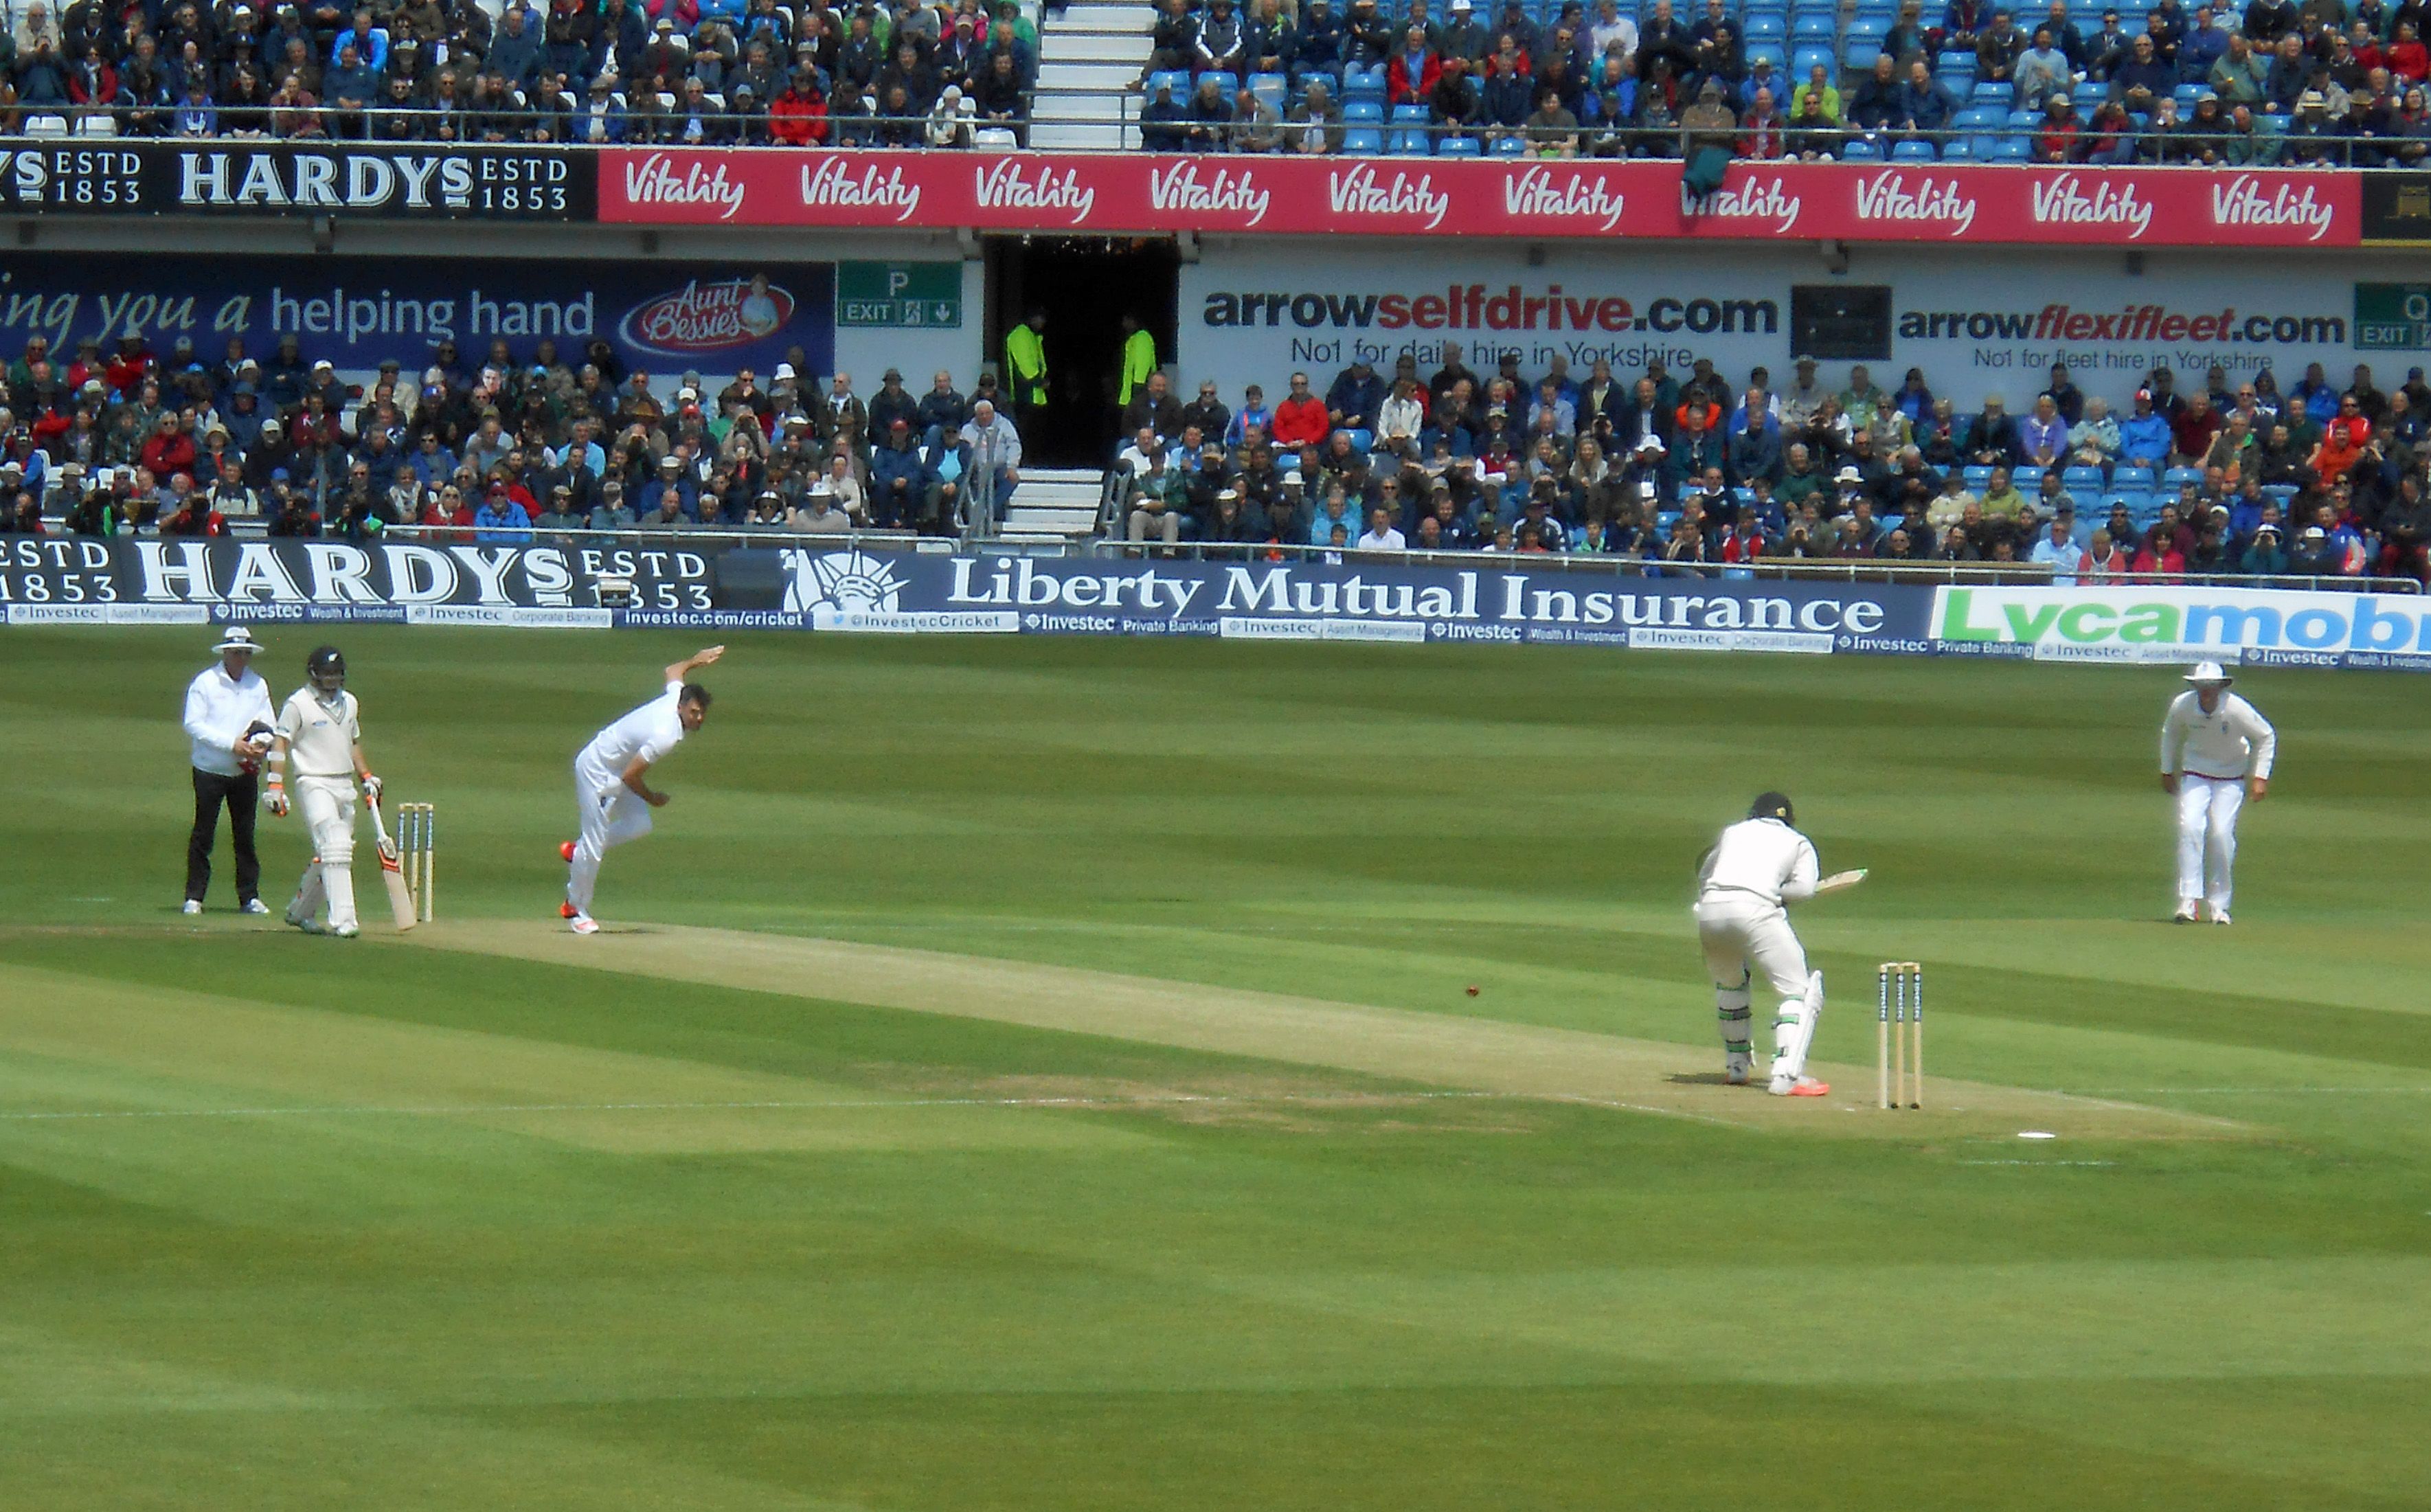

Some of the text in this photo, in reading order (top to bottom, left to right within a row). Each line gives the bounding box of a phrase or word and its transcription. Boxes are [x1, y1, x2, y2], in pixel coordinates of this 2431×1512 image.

[56, 151, 142, 174] ESTD
[483, 159, 567, 181] ESTD
[56, 180, 141, 203] 1853
[179, 153, 474, 208] HARDYS
[626, 153, 745, 218] Vitality
[801, 155, 920, 221] Vitality
[976, 157, 1094, 223] Vitality
[484, 188, 567, 210] 1853
[1151, 159, 1270, 226] Vitality
[1331, 162, 1449, 229] Vitality
[1505, 165, 1624, 231] Vitality
[1857, 169, 1976, 236] Vitality
[2033, 172, 2153, 238] Vitality
[2213, 174, 2333, 240] Vitality
[890, 271, 909, 296] P
[675, 278, 742, 316] Aunt
[95, 292, 196, 343] you
[214, 295, 251, 332] a
[272, 286, 455, 347] helping
[471, 291, 593, 336] hand
[847, 304, 891, 321] EXIT
[1203, 285, 1779, 334] arrowselfdrive.com
[1899, 305, 2345, 344] arrowflexifleet.com
[2364, 327, 2406, 342] EXIT
[1292, 337, 1341, 363] No1
[1353, 339, 1390, 363] for
[1533, 341, 1556, 365] in
[1564, 341, 1693, 368] Yorkshire
[1974, 349, 2274, 371] No1 for fleet hire in Yorkshire
[135, 542, 574, 608] HARDYS
[580, 550, 707, 578] ESTD
[948, 558, 1885, 633] Liberty Mutual Insurance
[30, 605, 98, 618] Investec
[231, 604, 303, 620] Investec
[430, 607, 504, 620] Investec
[626, 609, 803, 627] Investec.com/cricket
[851, 616, 999, 628] @InvestecCricket
[1042, 614, 1115, 631] Investec
[1123, 620, 1218, 634] Private Banking
[1245, 621, 1316, 634] Investec
[1448, 623, 1522, 640] Investec
[1652, 631, 1725, 645] Investec
[1854, 635, 1928, 652] Investec
[1937, 641, 2033, 656] Private Banking
[2057, 644, 2131, 657] Investec
[2263, 648, 2339, 665] Investec
